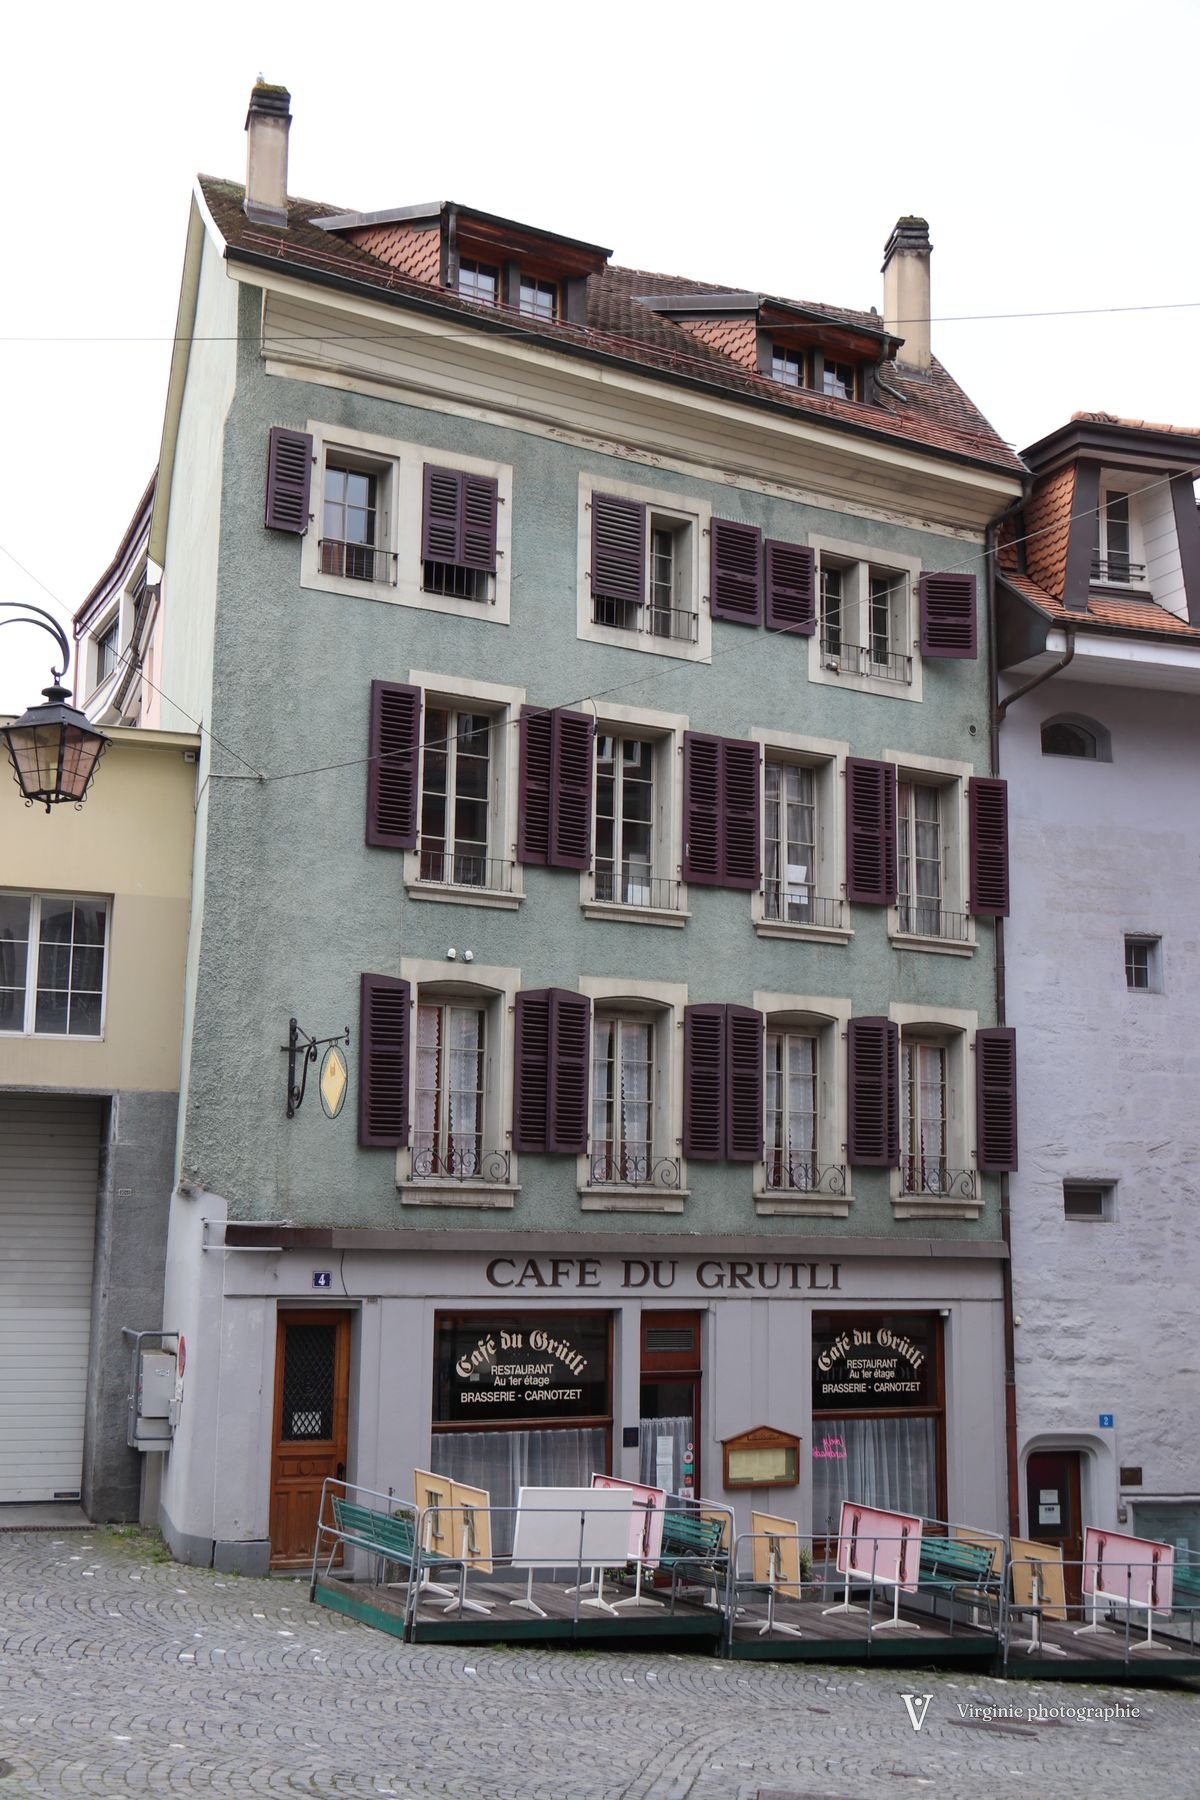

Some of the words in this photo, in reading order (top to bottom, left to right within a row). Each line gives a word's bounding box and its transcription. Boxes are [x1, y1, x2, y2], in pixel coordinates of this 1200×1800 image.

[317, 1273, 326, 1286] 4
[620, 1259, 679, 1288] DU
[696, 1260, 842, 1290] GRUTLI
[455, 1333, 497, 1378] Café
[500, 1329, 523, 1350] du
[529, 1329, 588, 1376] Grütli
[817, 1331, 851, 1372] Café
[853, 1328, 872, 1346] du
[876, 1328, 925, 1370] Grütli
[491, 1363, 554, 1376] RESTAURANT
[846, 1358, 898, 1369] RESTAURANT
[849, 1369, 860, 1379] Au
[862, 1369, 872, 1379] 1er
[873, 1368, 896, 1380] étage
[494, 1376, 506, 1386] Au
[508, 1376, 522, 1386] 1er
[524, 1375, 550, 1387] étage
[822, 1383, 867, 1394] BRASSERIE
[873, 1381, 921, 1393] CARNOTZET
[460, 1391, 516, 1403] BRASSERIE
[524, 1389, 582, 1401] CARNOTZET
